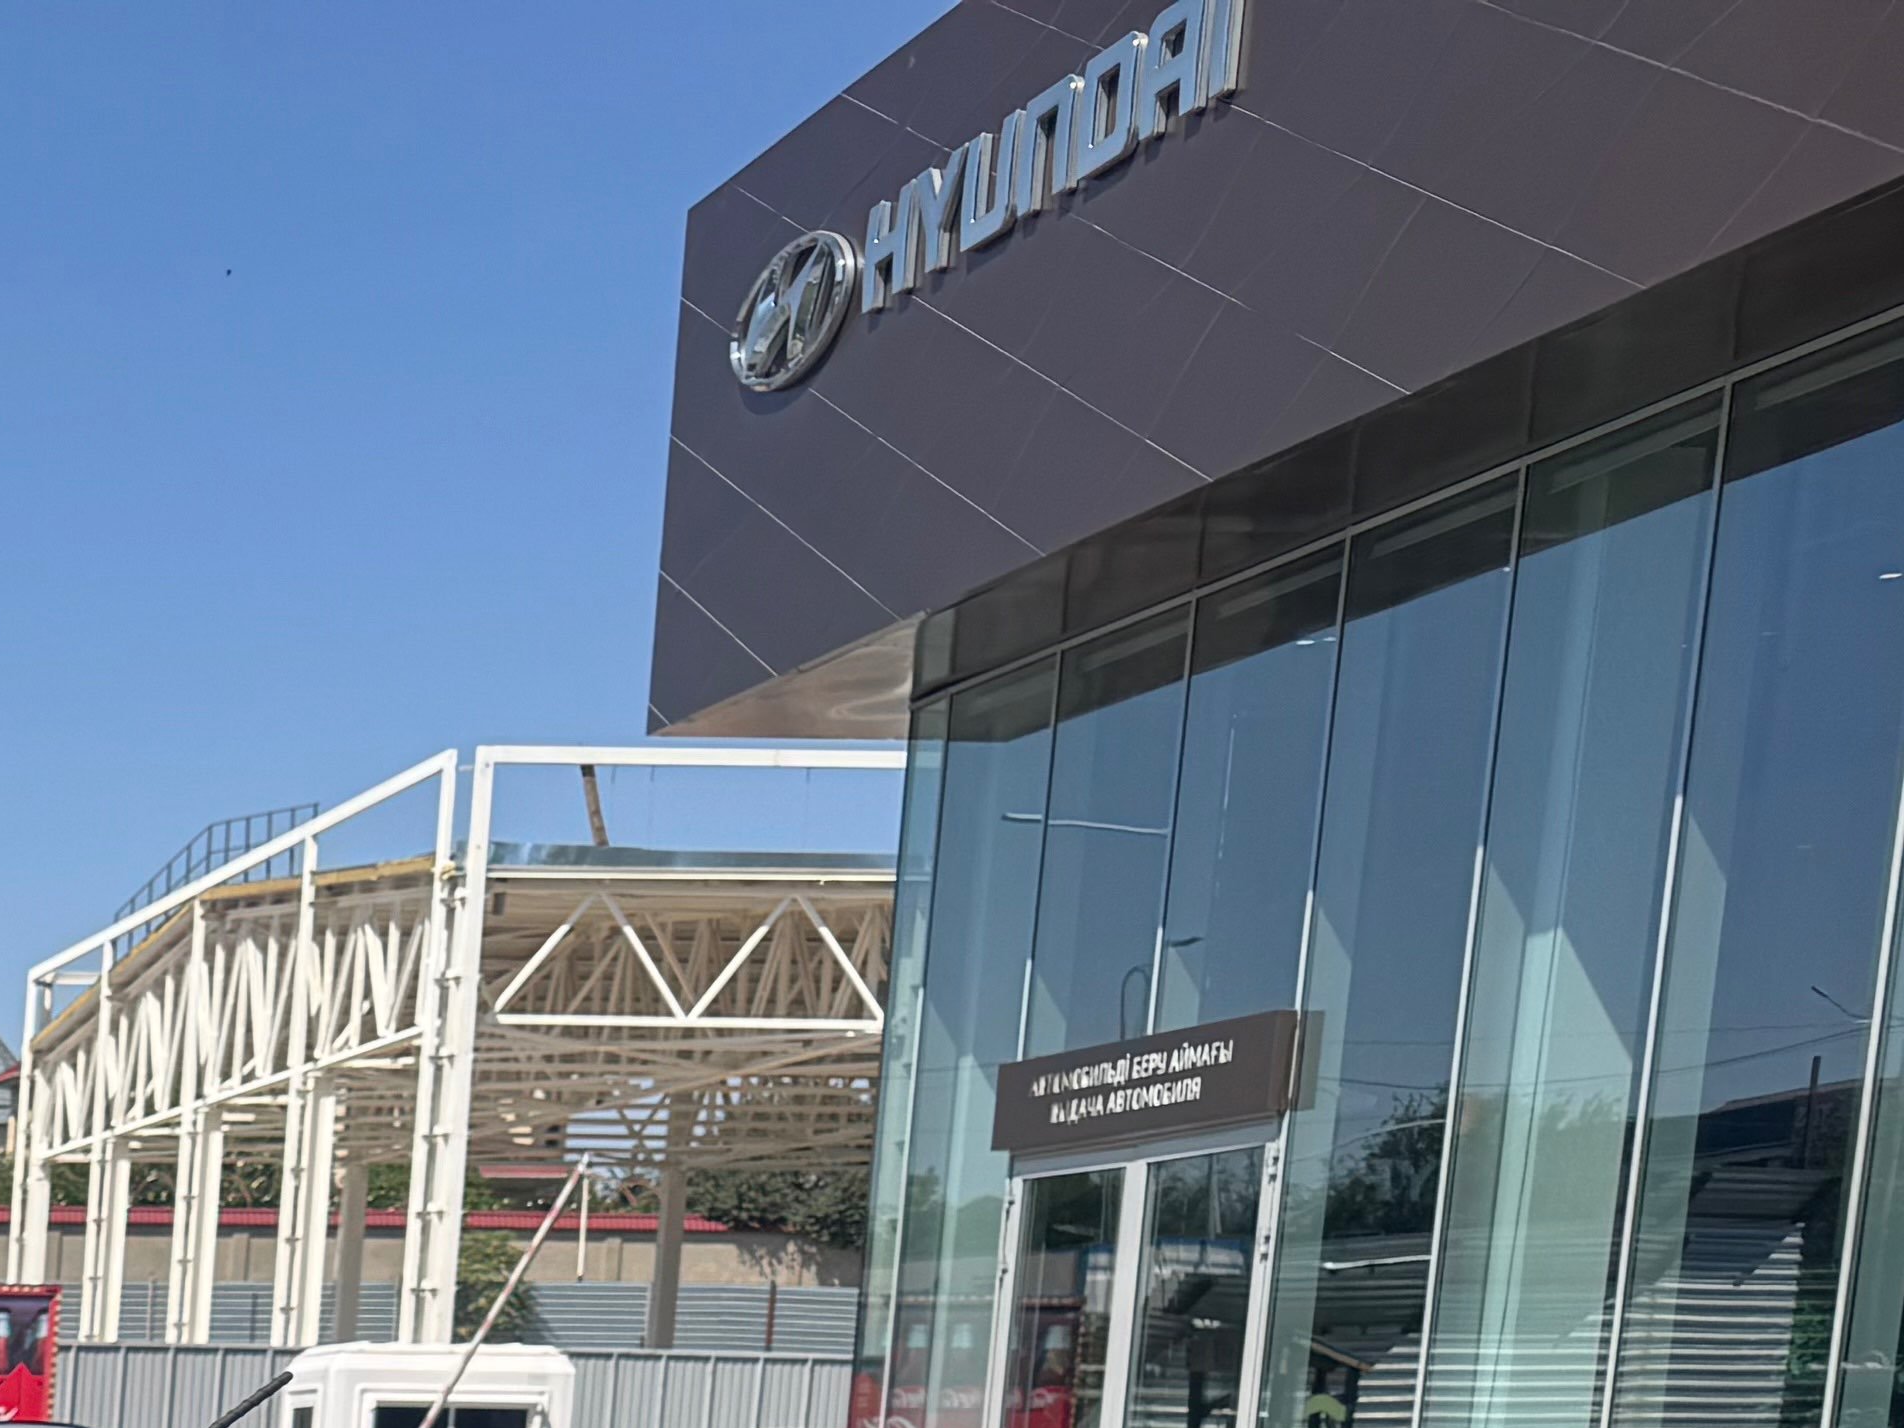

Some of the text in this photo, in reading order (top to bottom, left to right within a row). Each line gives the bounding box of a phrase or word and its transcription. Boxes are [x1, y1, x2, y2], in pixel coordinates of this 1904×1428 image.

[862, 0, 1244, 314] HYUNDAI
[1131, 1048, 1168, 1079] БЕРУ
[1105, 1076, 1202, 1115] АВТОМОБИЛЯ
